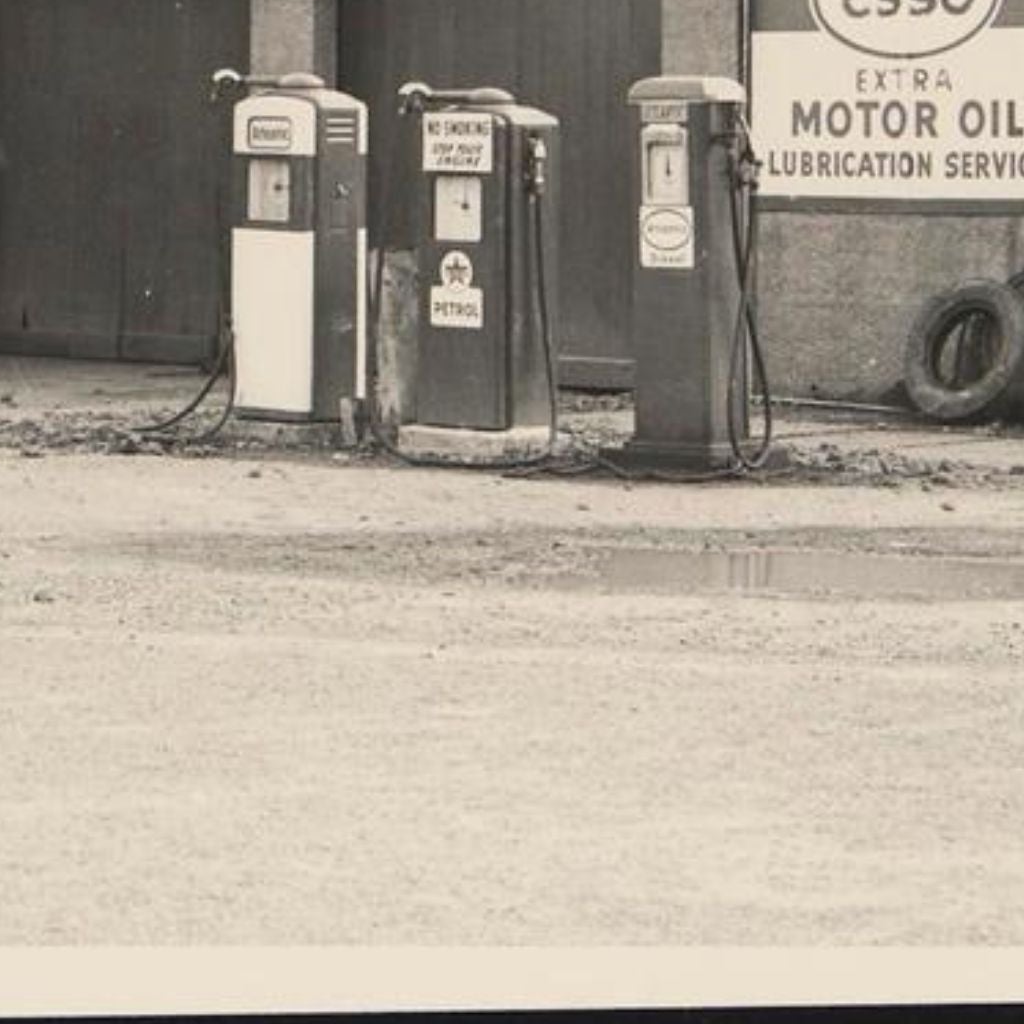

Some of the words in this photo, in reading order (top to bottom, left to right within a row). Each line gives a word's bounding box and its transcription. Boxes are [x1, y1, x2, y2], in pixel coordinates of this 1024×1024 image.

[856, 68, 953, 92] EXTRA
[428, 120, 442, 135] NO
[444, 120, 491, 136] SMOKING
[791, 99, 938, 139] MOTOR
[959, 99, 1024, 139] OIL
[769, 150, 932, 179] LUBRICATION
[433, 301, 480, 319] PETROL
